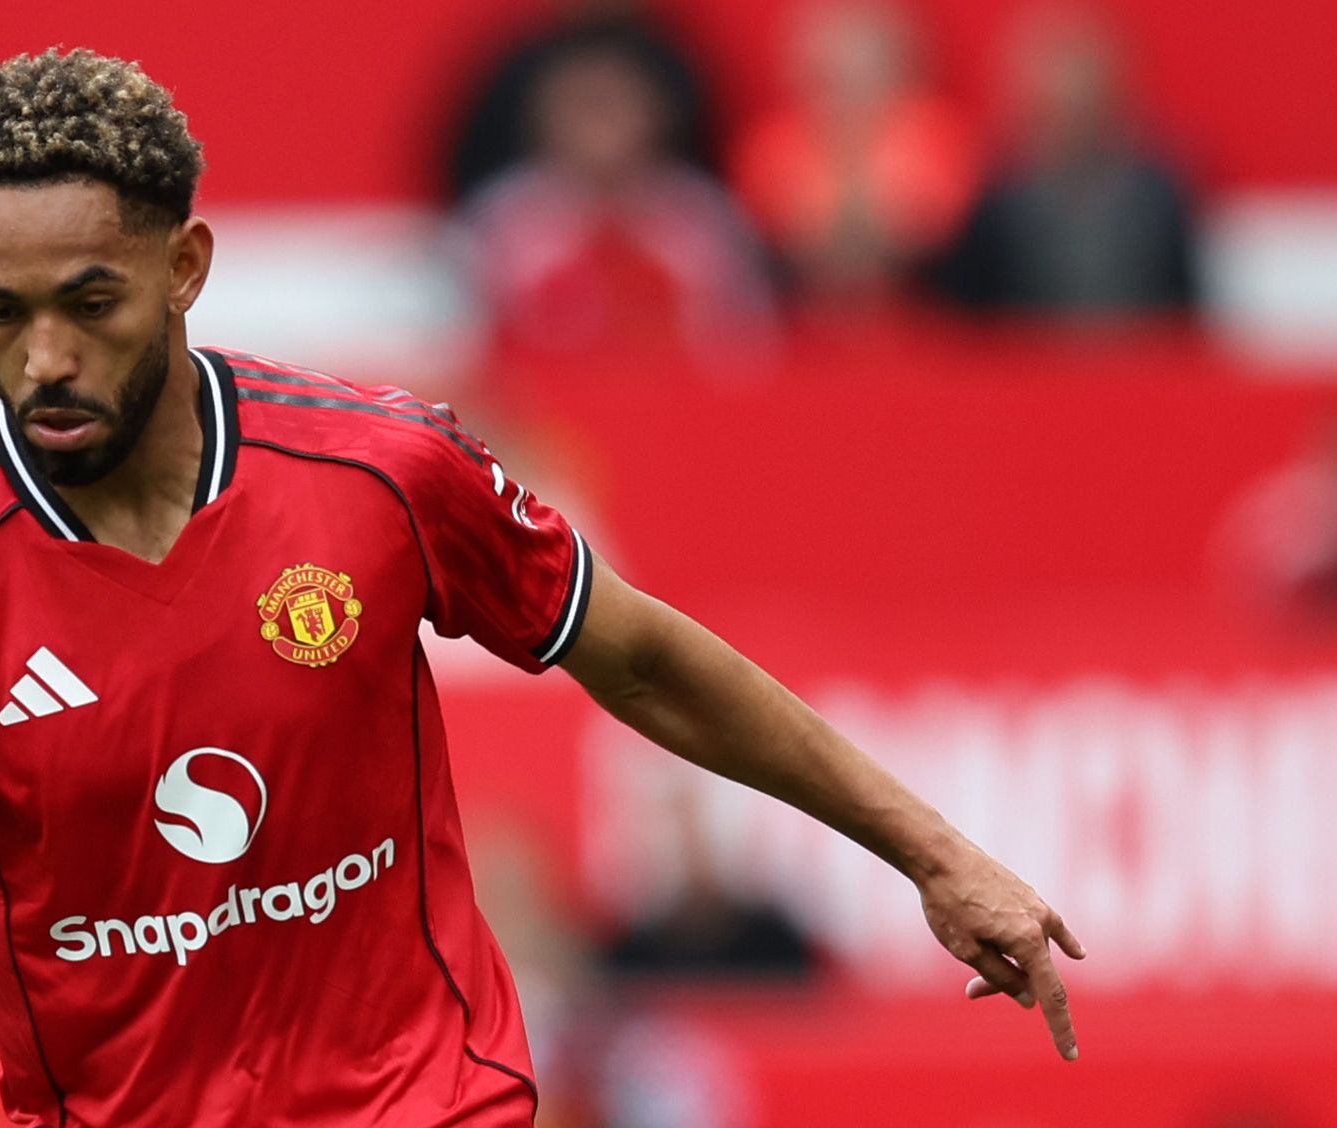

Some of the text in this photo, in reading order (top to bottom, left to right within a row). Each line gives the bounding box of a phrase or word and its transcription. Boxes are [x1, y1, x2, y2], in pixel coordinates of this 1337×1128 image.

[266, 570, 347, 614] MANCHESTER
[291, 635, 349, 661] UNITED
[49, 837, 396, 967] Snapdragon
